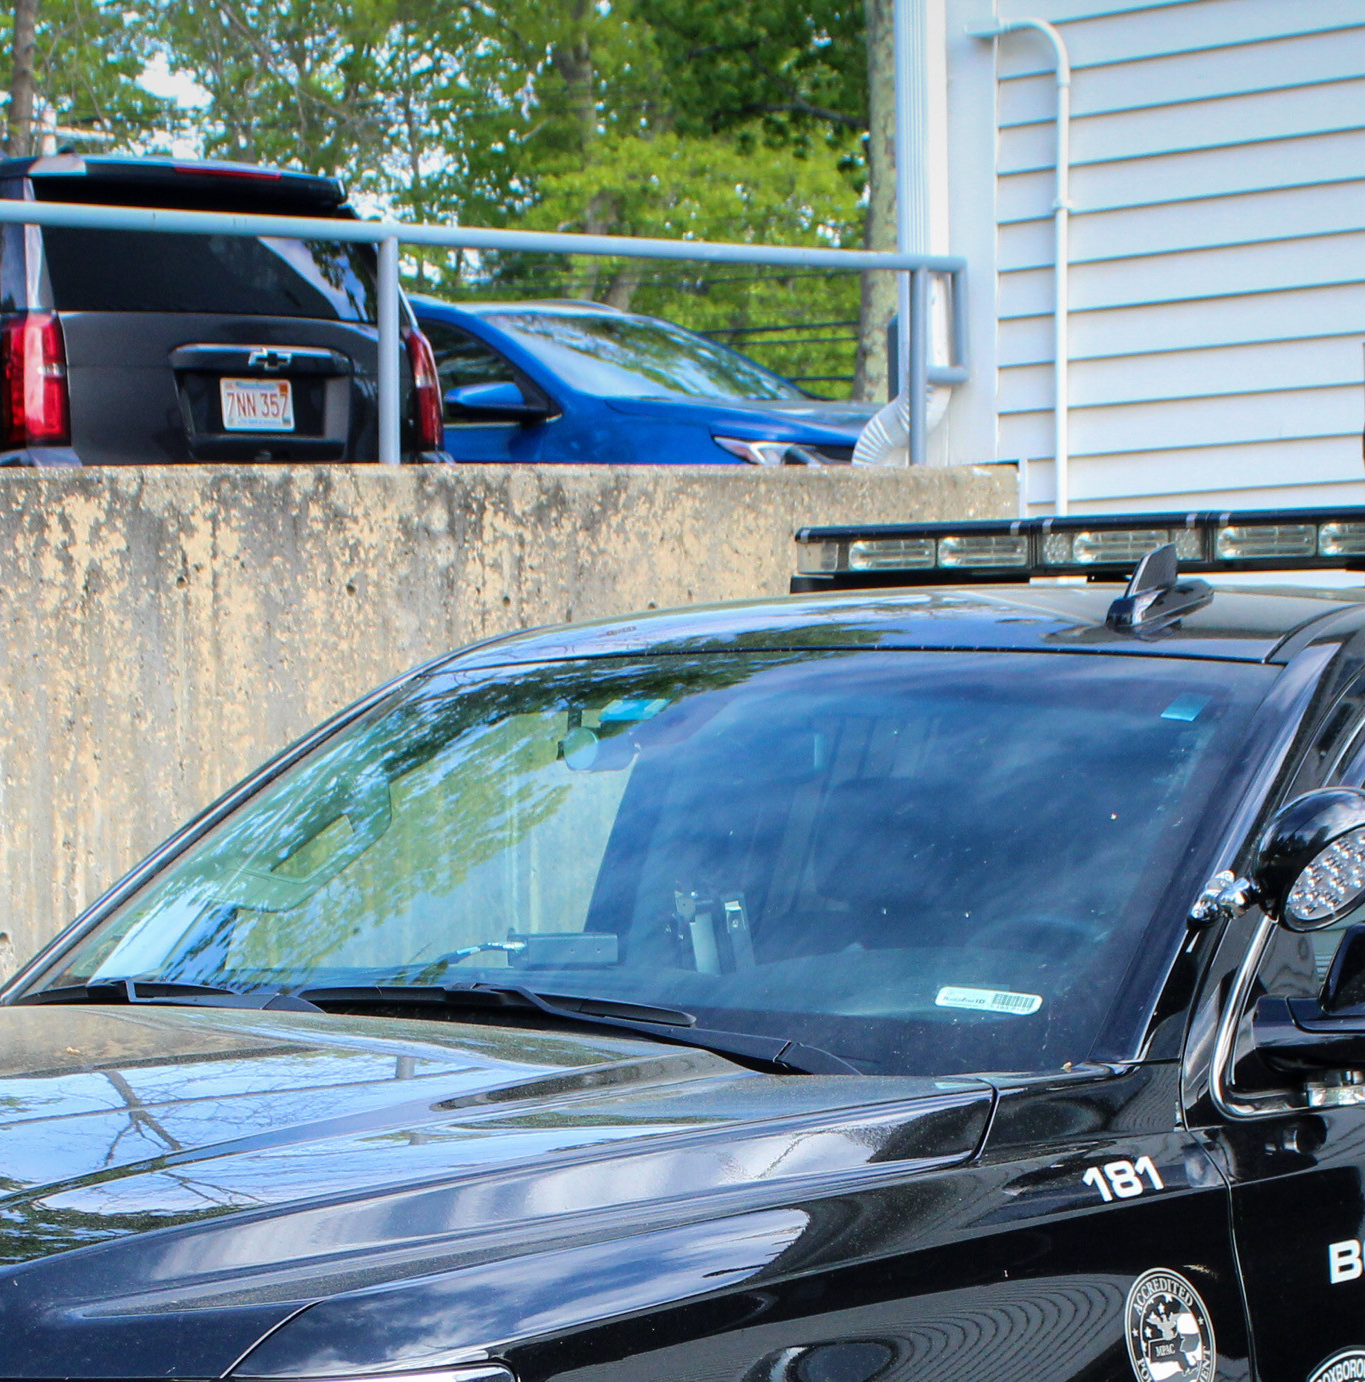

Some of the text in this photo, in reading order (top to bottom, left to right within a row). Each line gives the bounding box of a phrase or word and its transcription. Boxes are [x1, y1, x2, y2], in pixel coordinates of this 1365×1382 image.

[259, 392, 289, 418] 357
[1082, 1155, 1165, 1202] 181
[1133, 1278, 1193, 1316] ACCREDITED
[1155, 1344, 1176, 1357] MPAC
